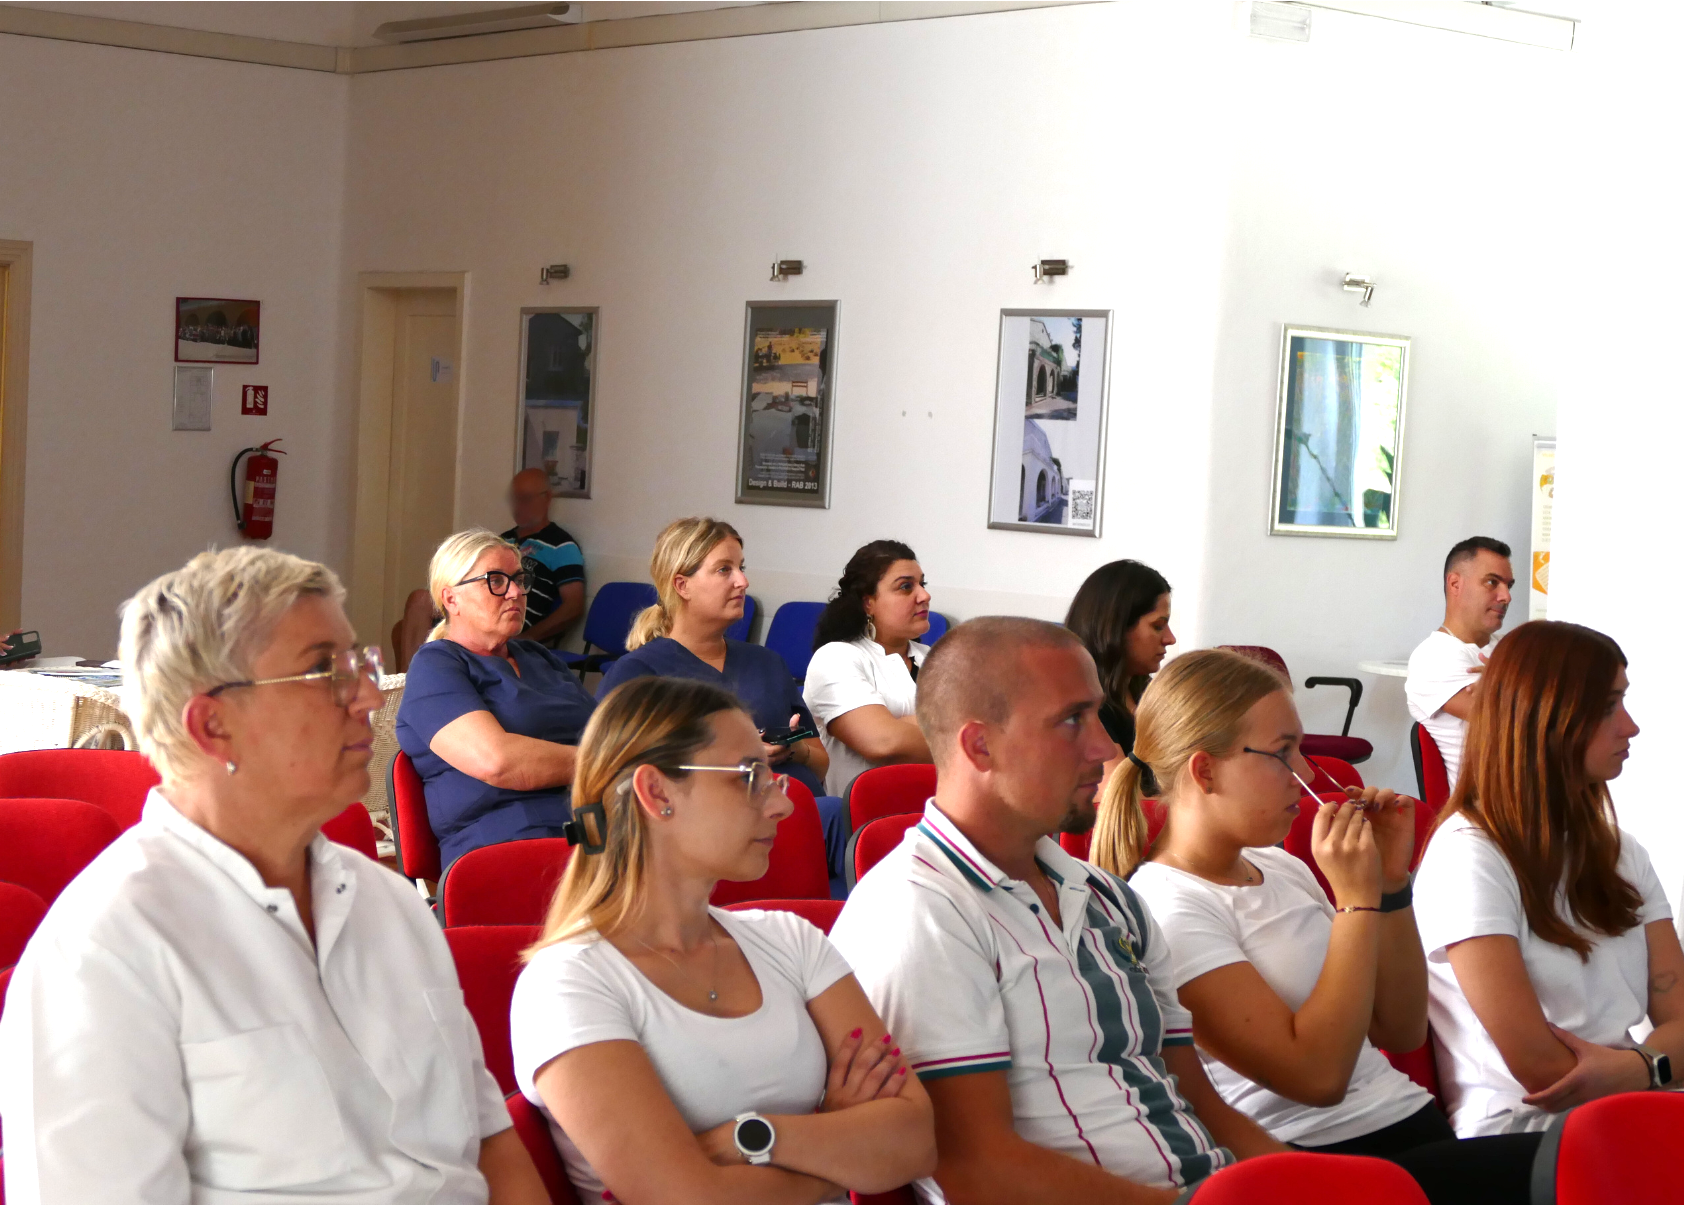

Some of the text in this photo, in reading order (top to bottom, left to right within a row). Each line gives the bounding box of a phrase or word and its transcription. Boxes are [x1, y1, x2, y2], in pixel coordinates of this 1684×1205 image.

[748, 479, 767, 488] Design
[792, 481, 804, 489] RAB
[805, 482, 818, 490] 2013
